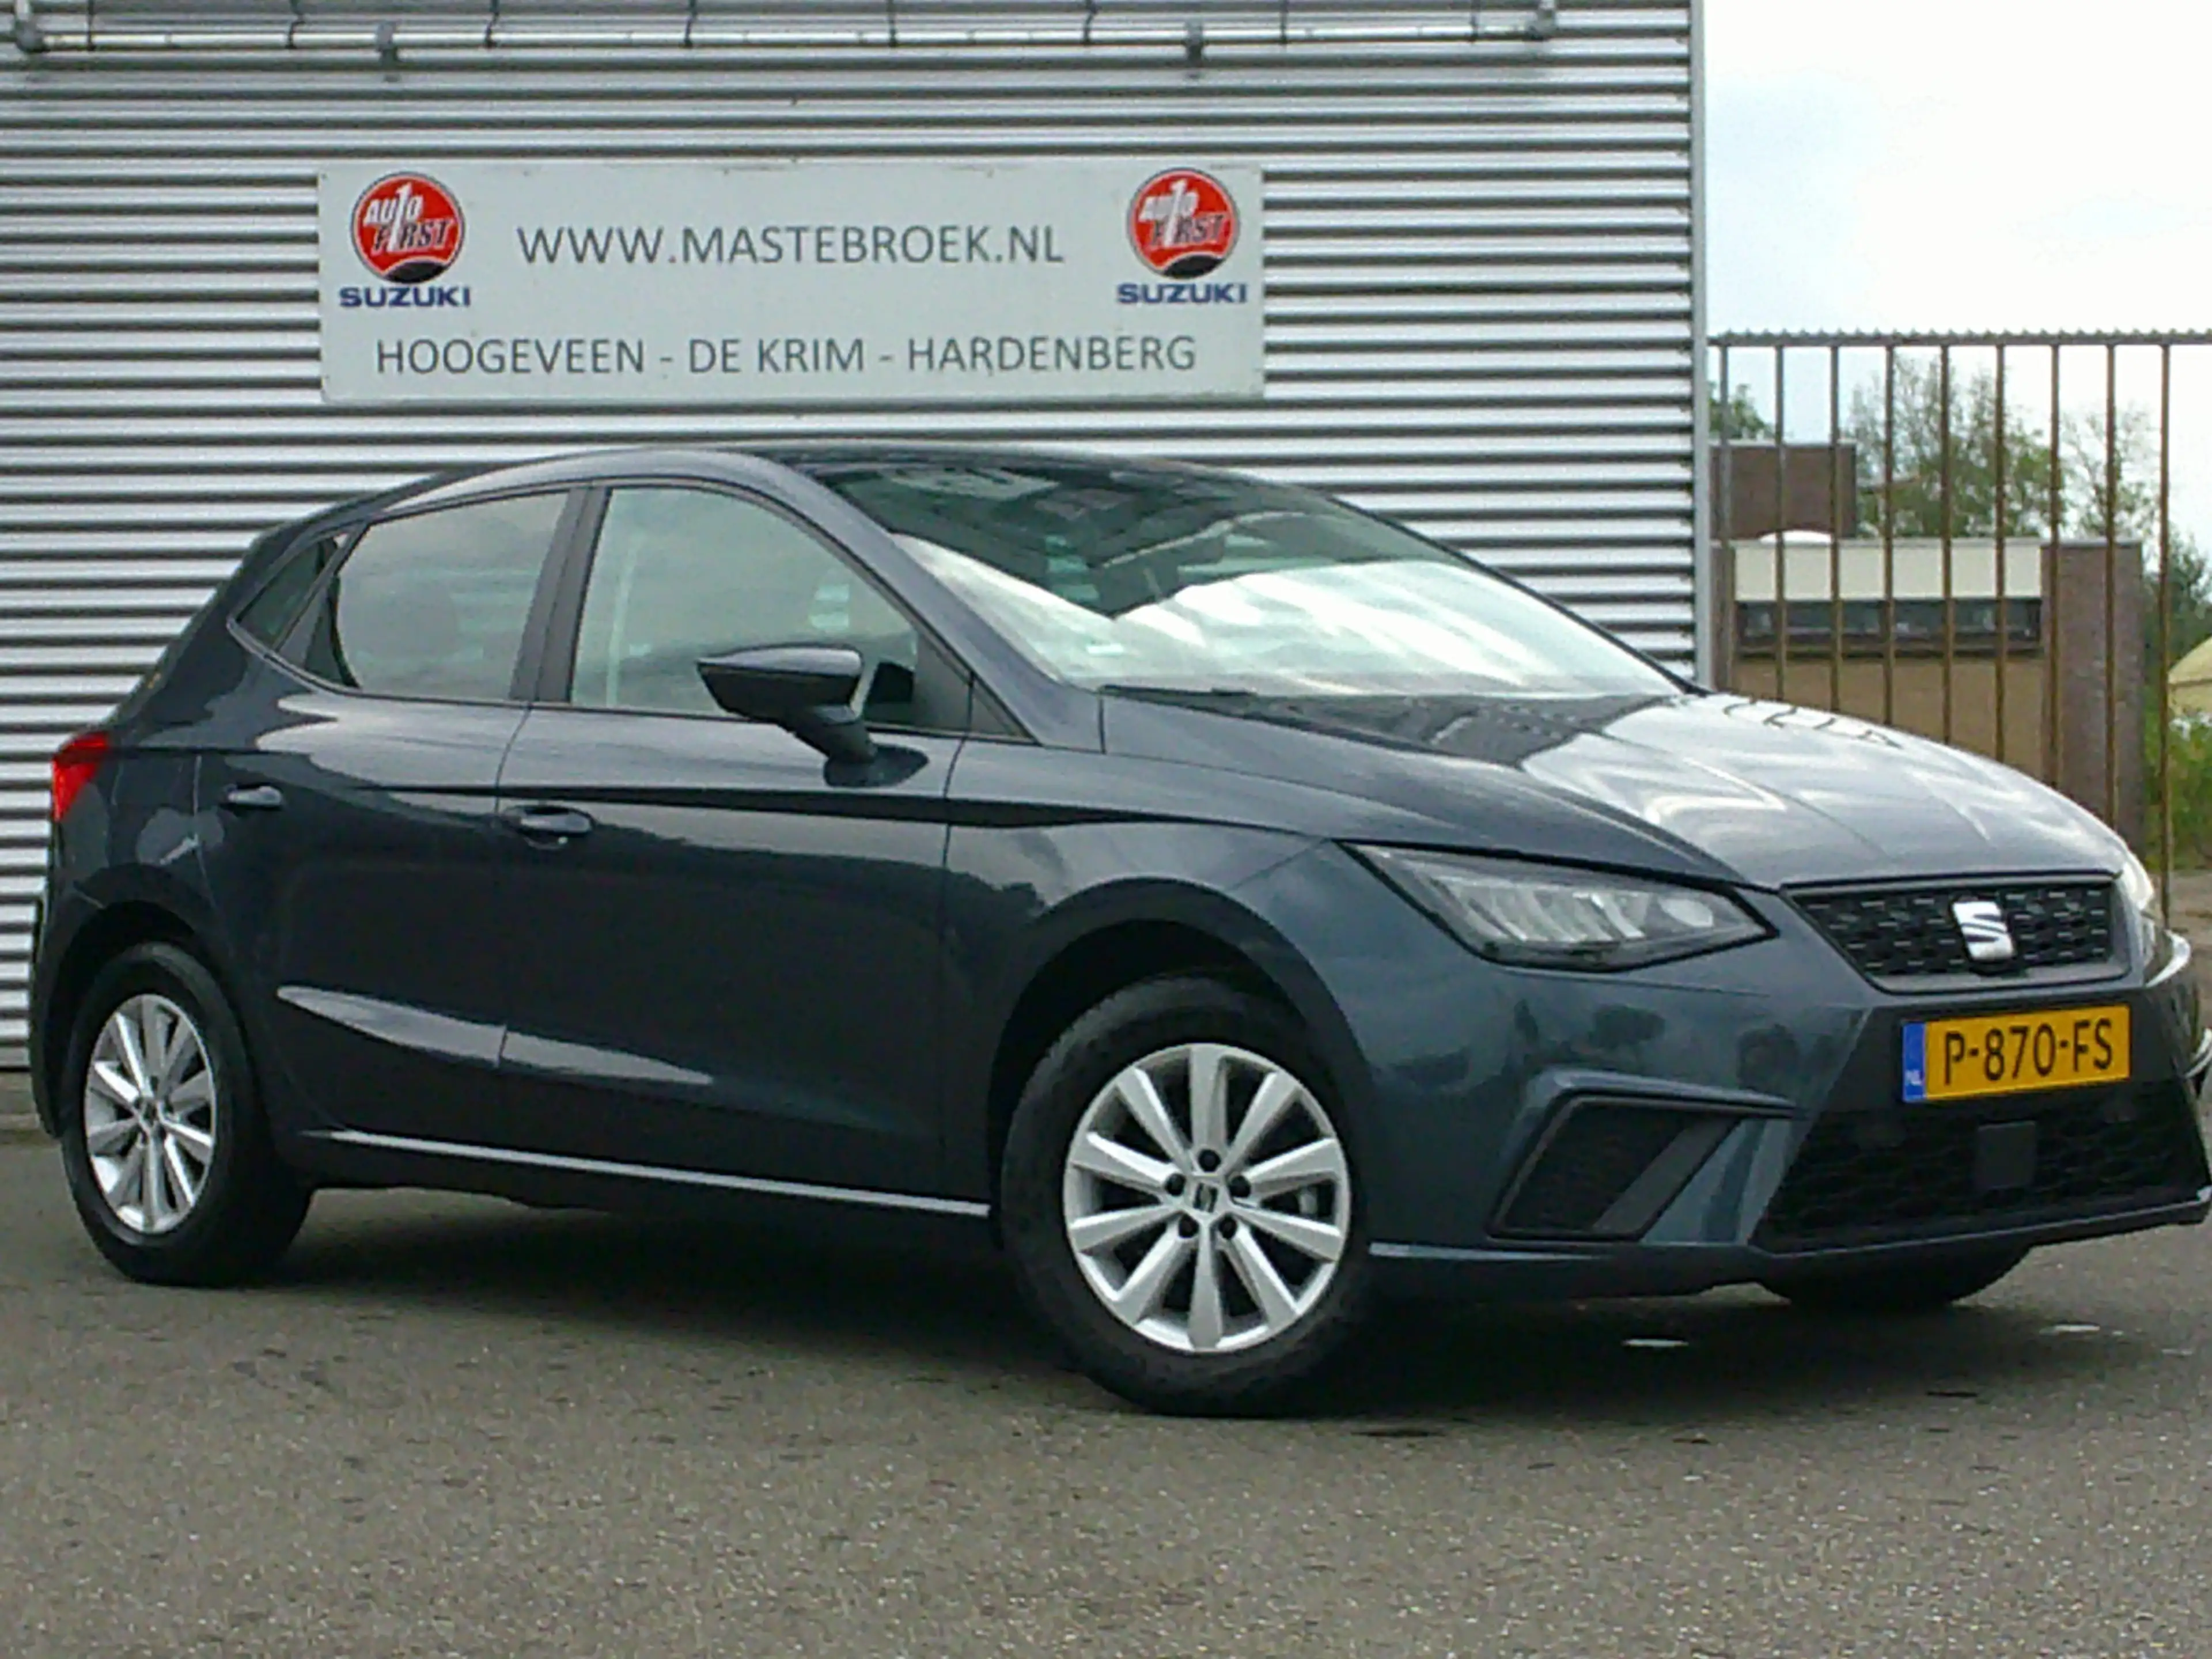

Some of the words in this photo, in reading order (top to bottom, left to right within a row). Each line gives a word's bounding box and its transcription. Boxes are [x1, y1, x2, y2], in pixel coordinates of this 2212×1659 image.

[517, 225, 1063, 264] WWW.MASTEBROEK.NL
[339, 286, 471, 308] SUZUKI
[1117, 283, 1247, 304] SUZUKI
[377, 339, 643, 374] HOOGEVEEN
[690, 339, 740, 373] DE
[758, 339, 863, 373] KRIM
[909, 336, 1195, 371] HARDENBERG
[1945, 1018, 2112, 1085] P-870-FS
